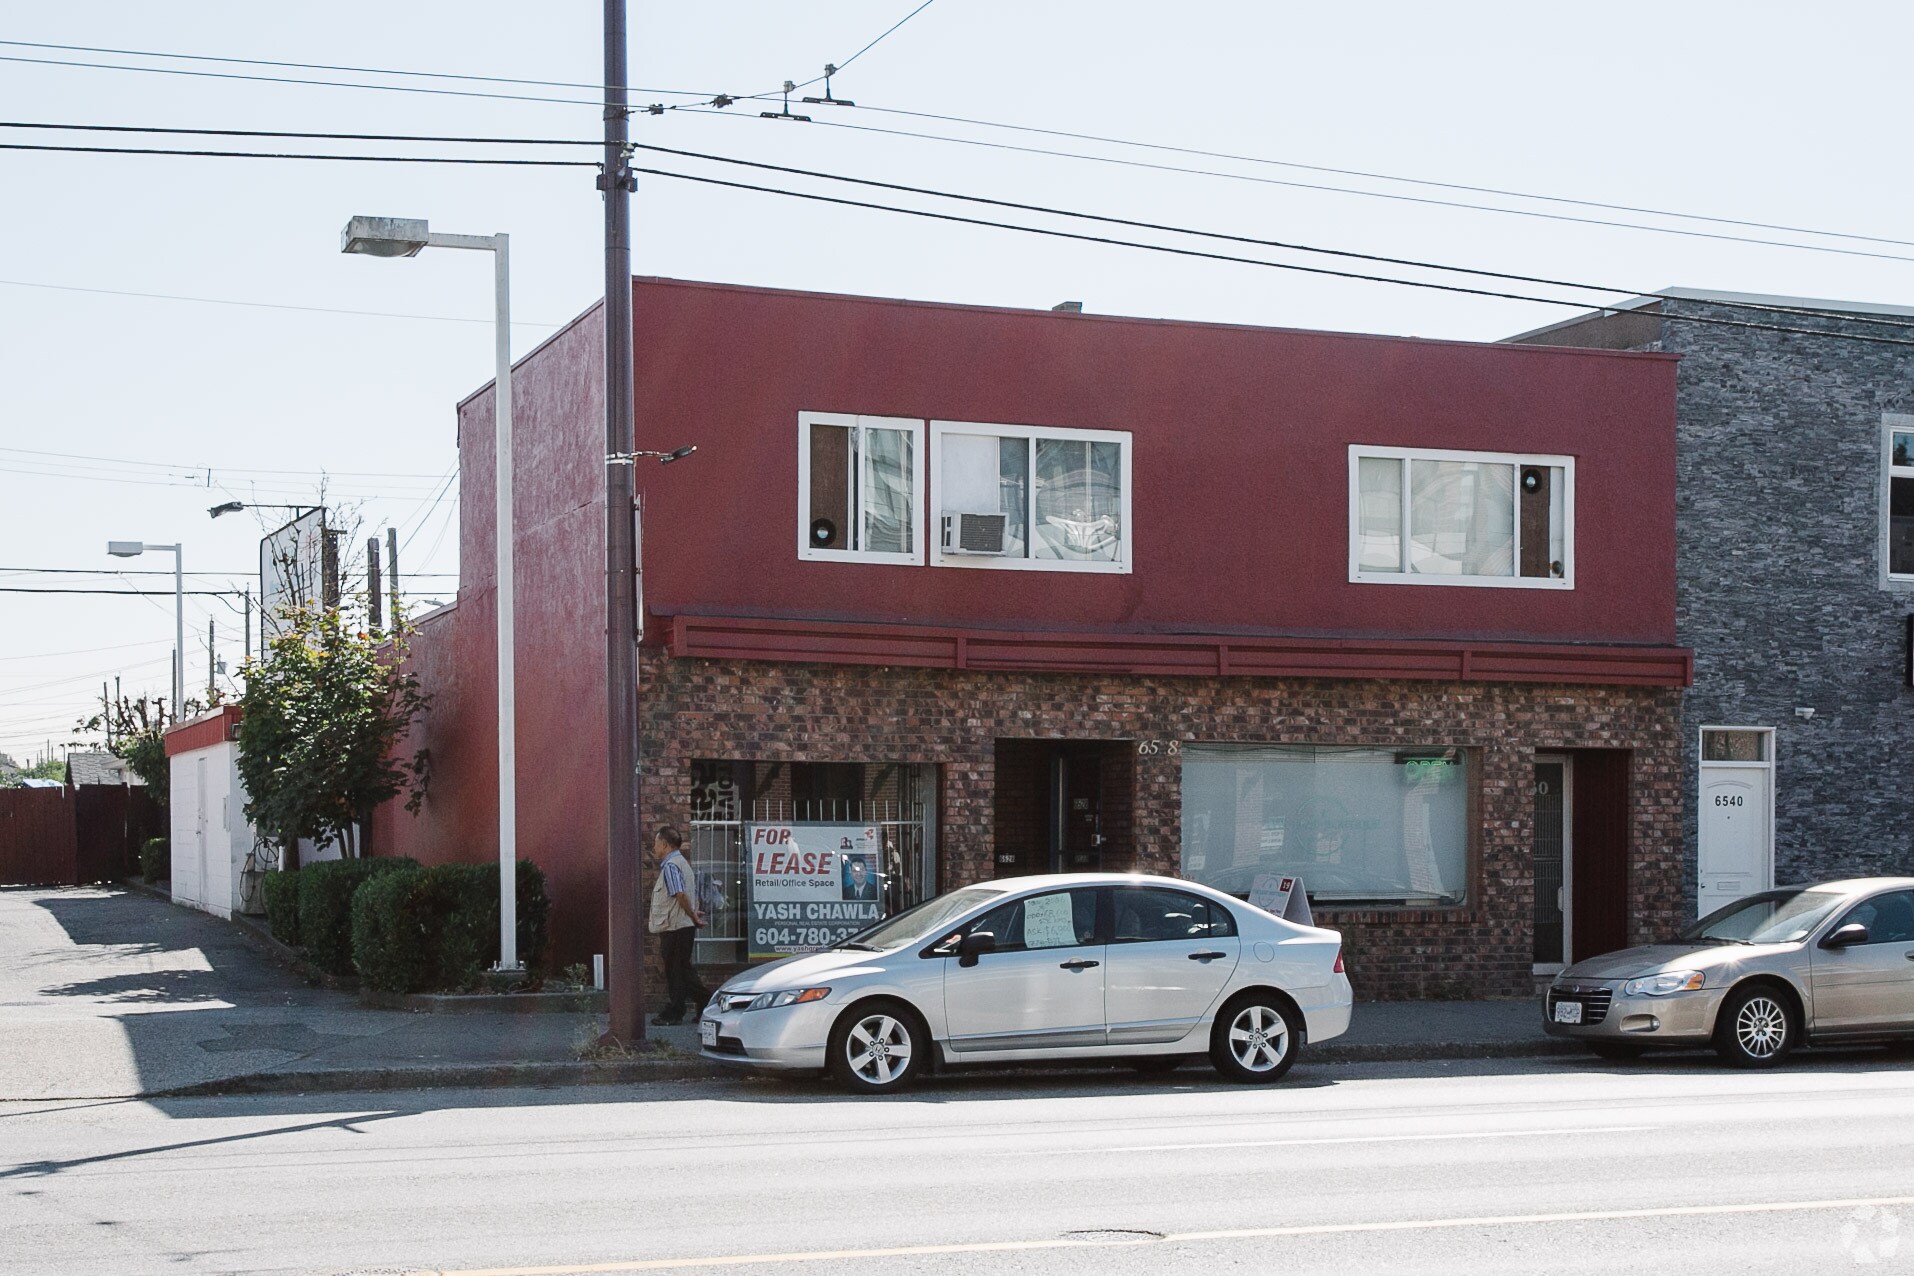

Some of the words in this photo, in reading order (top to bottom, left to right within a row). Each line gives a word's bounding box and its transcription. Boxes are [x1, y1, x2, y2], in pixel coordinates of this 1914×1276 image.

[1714, 795, 1744, 807] 6540
[754, 828, 791, 845] FOR
[755, 852, 833, 875] LEASE
[755, 879, 807, 887] Retail/Office
[808, 879, 835, 888] Space
[754, 903, 800, 919] YASH
[806, 903, 879, 919] CHAWLA
[755, 928, 863, 944] 604-780-37
